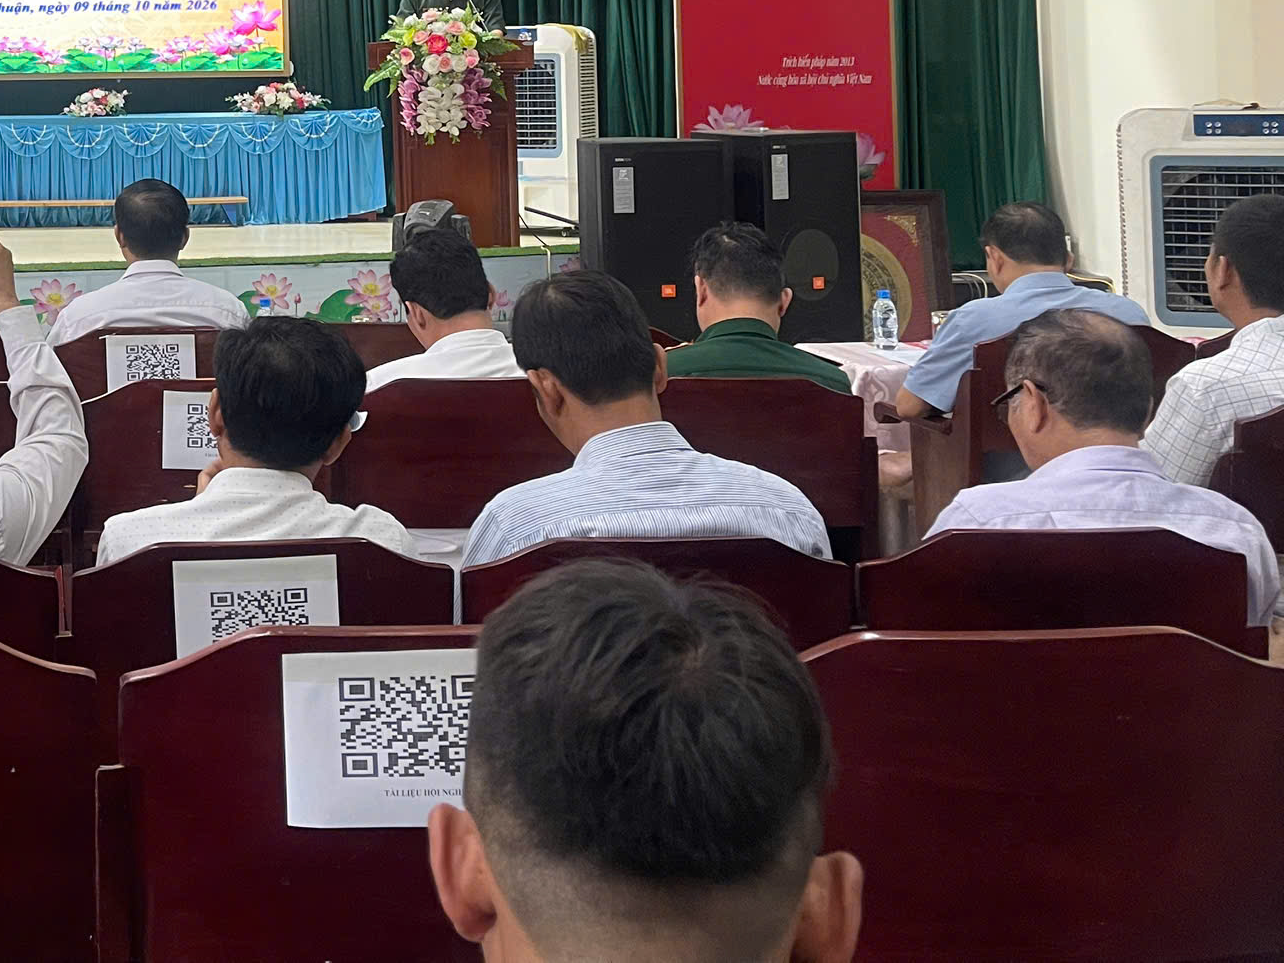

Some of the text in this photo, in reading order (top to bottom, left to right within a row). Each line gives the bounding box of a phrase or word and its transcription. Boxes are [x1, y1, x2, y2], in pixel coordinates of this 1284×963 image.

[39, 2, 70, 15] ngày
[73, 1, 90, 13] 09
[93, 1, 130, 14] tháng
[135, 0, 150, 12] 10
[153, 0, 182, 12] năm
[186, 0, 217, 12] 2026
[384, 787, 463, 799] TÀI LIỆU HỘI NGH
